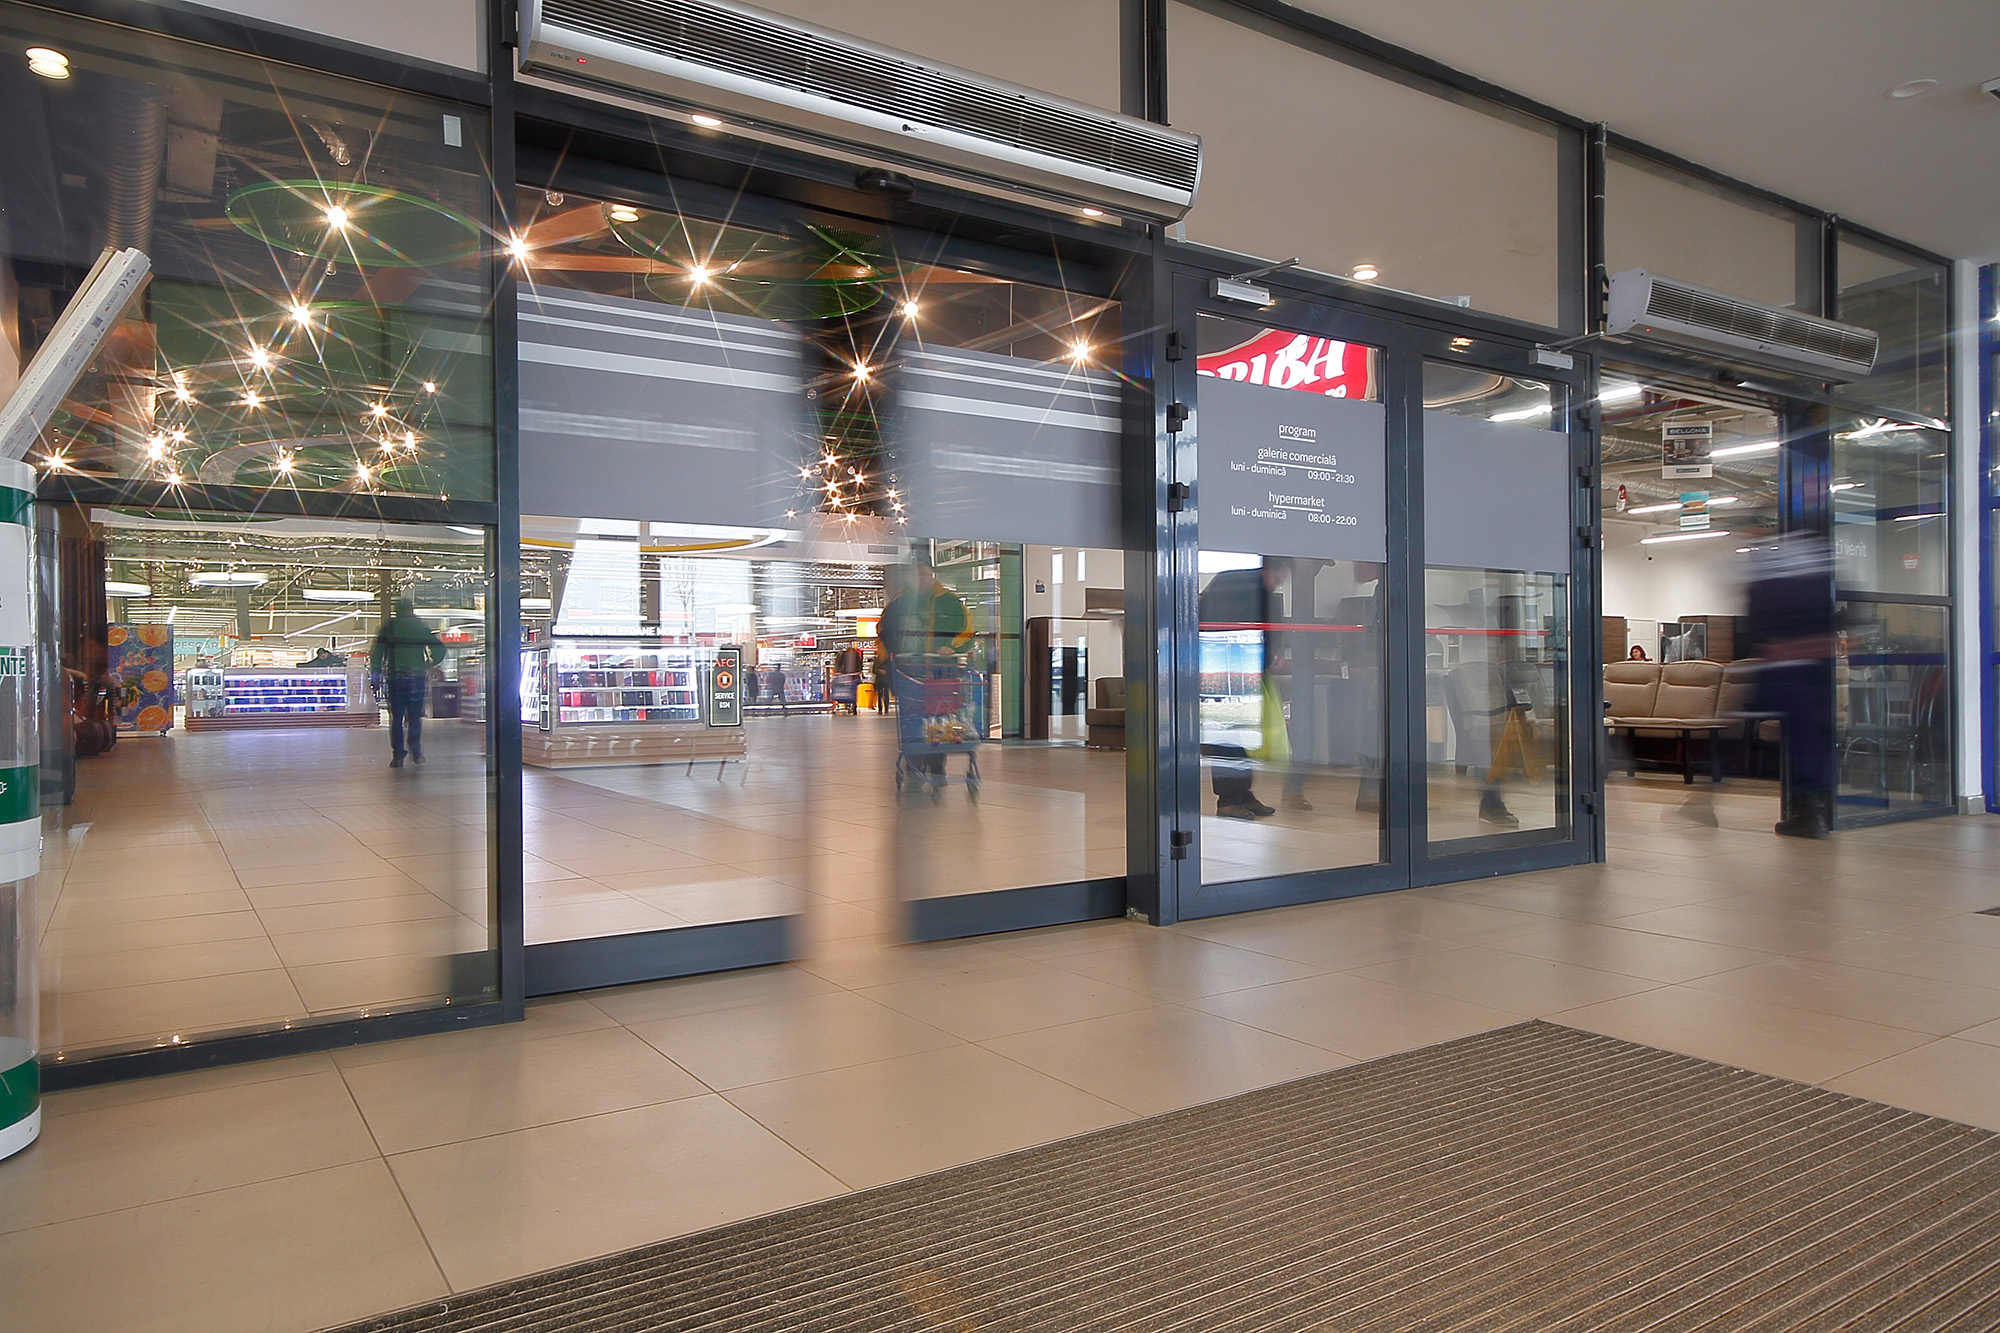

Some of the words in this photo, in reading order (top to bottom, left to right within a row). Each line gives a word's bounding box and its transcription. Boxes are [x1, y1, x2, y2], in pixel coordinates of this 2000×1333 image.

[1278, 424, 1317, 438] program
[1257, 447, 1288, 460] galerie
[1288, 453, 1337, 466] comercială
[1230, 461, 1246, 471] luni
[1250, 463, 1287, 477] duminică
[1307, 470, 1331, 481] 09:00
[1335, 473, 1355, 484] 21:30
[1268, 491, 1326, 507] hypermarket
[1231, 505, 1246, 516] luni
[1251, 507, 1287, 520] duminică
[1307, 513, 1331, 524] 08:00
[1335, 515, 1357, 526] 22:00
[0, 656, 26, 675] NTE
[713, 658, 736, 668] AFC
[714, 691, 735, 700] SERVICE
